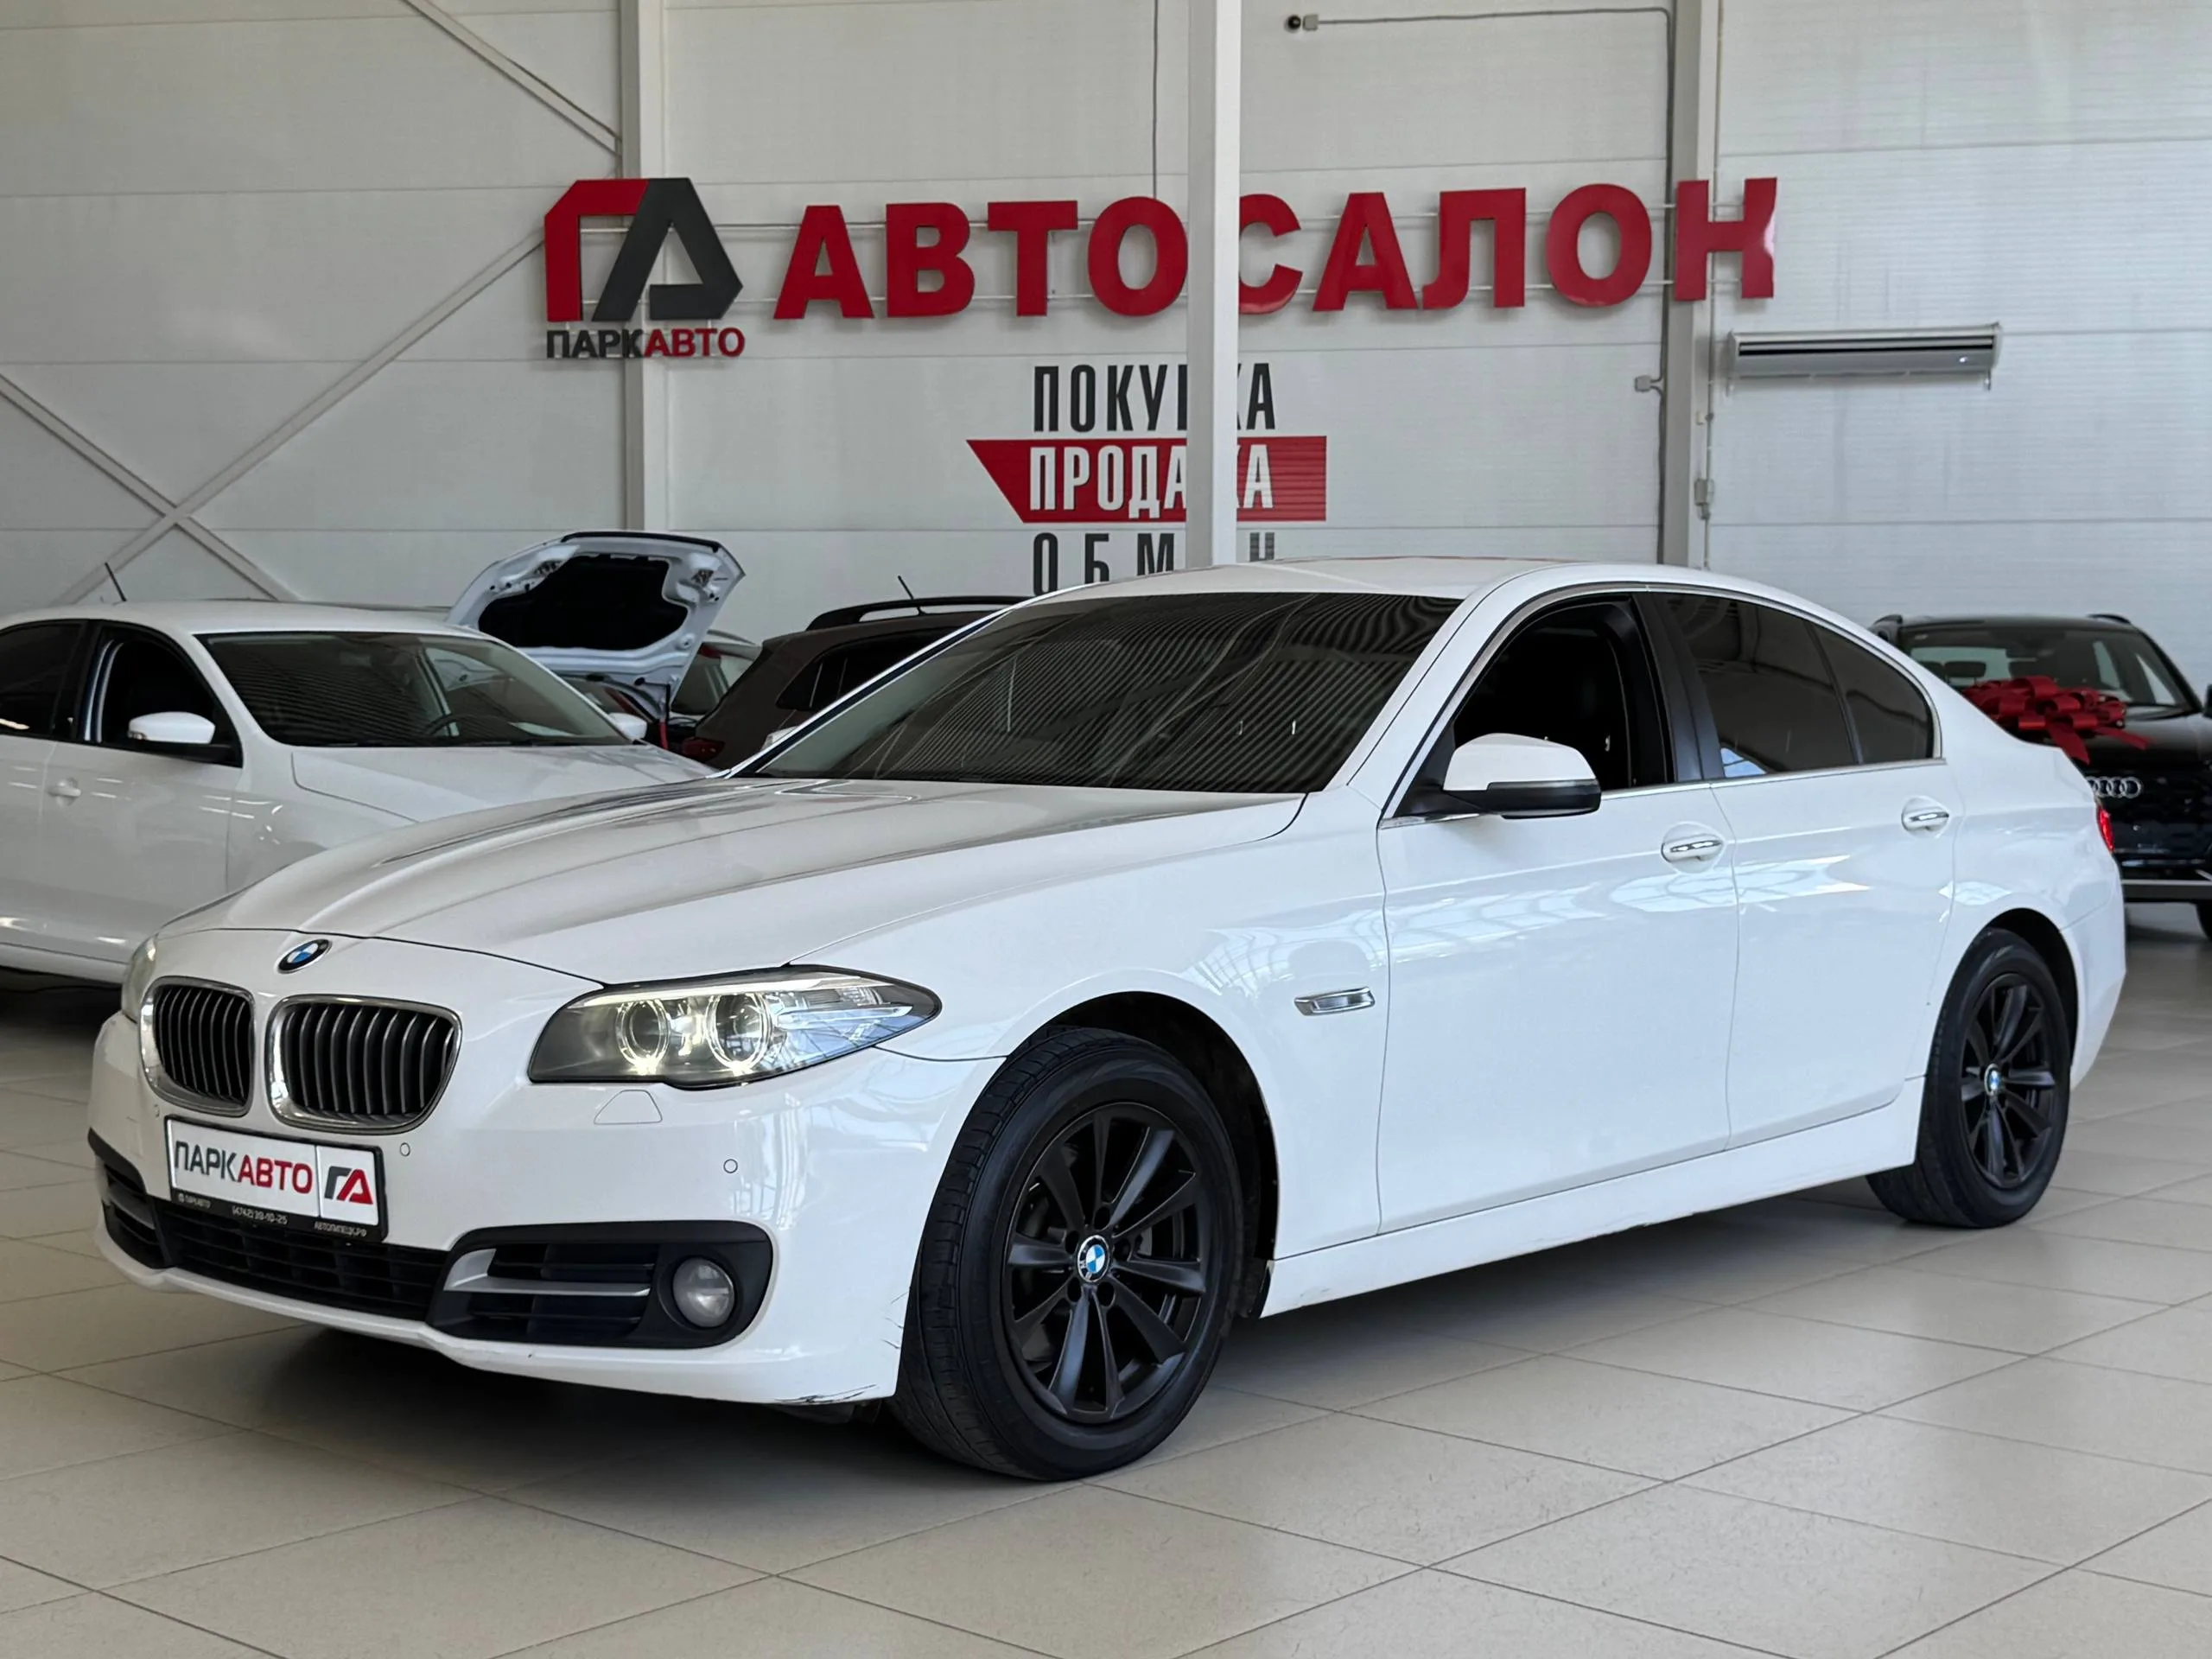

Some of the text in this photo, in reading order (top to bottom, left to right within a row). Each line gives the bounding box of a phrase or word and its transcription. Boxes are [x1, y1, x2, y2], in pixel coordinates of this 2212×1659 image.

[773, 178, 1778, 320] АВТОСАЛОН
[546, 327, 746, 359] ПАРКАВТО
[1033, 363, 1275, 433] ПОКУА
[1029, 444, 1274, 519] ПРОДАА
[1033, 532, 1275, 597] ОБМ
[175, 1140, 314, 1194] ПАРКАВТО
